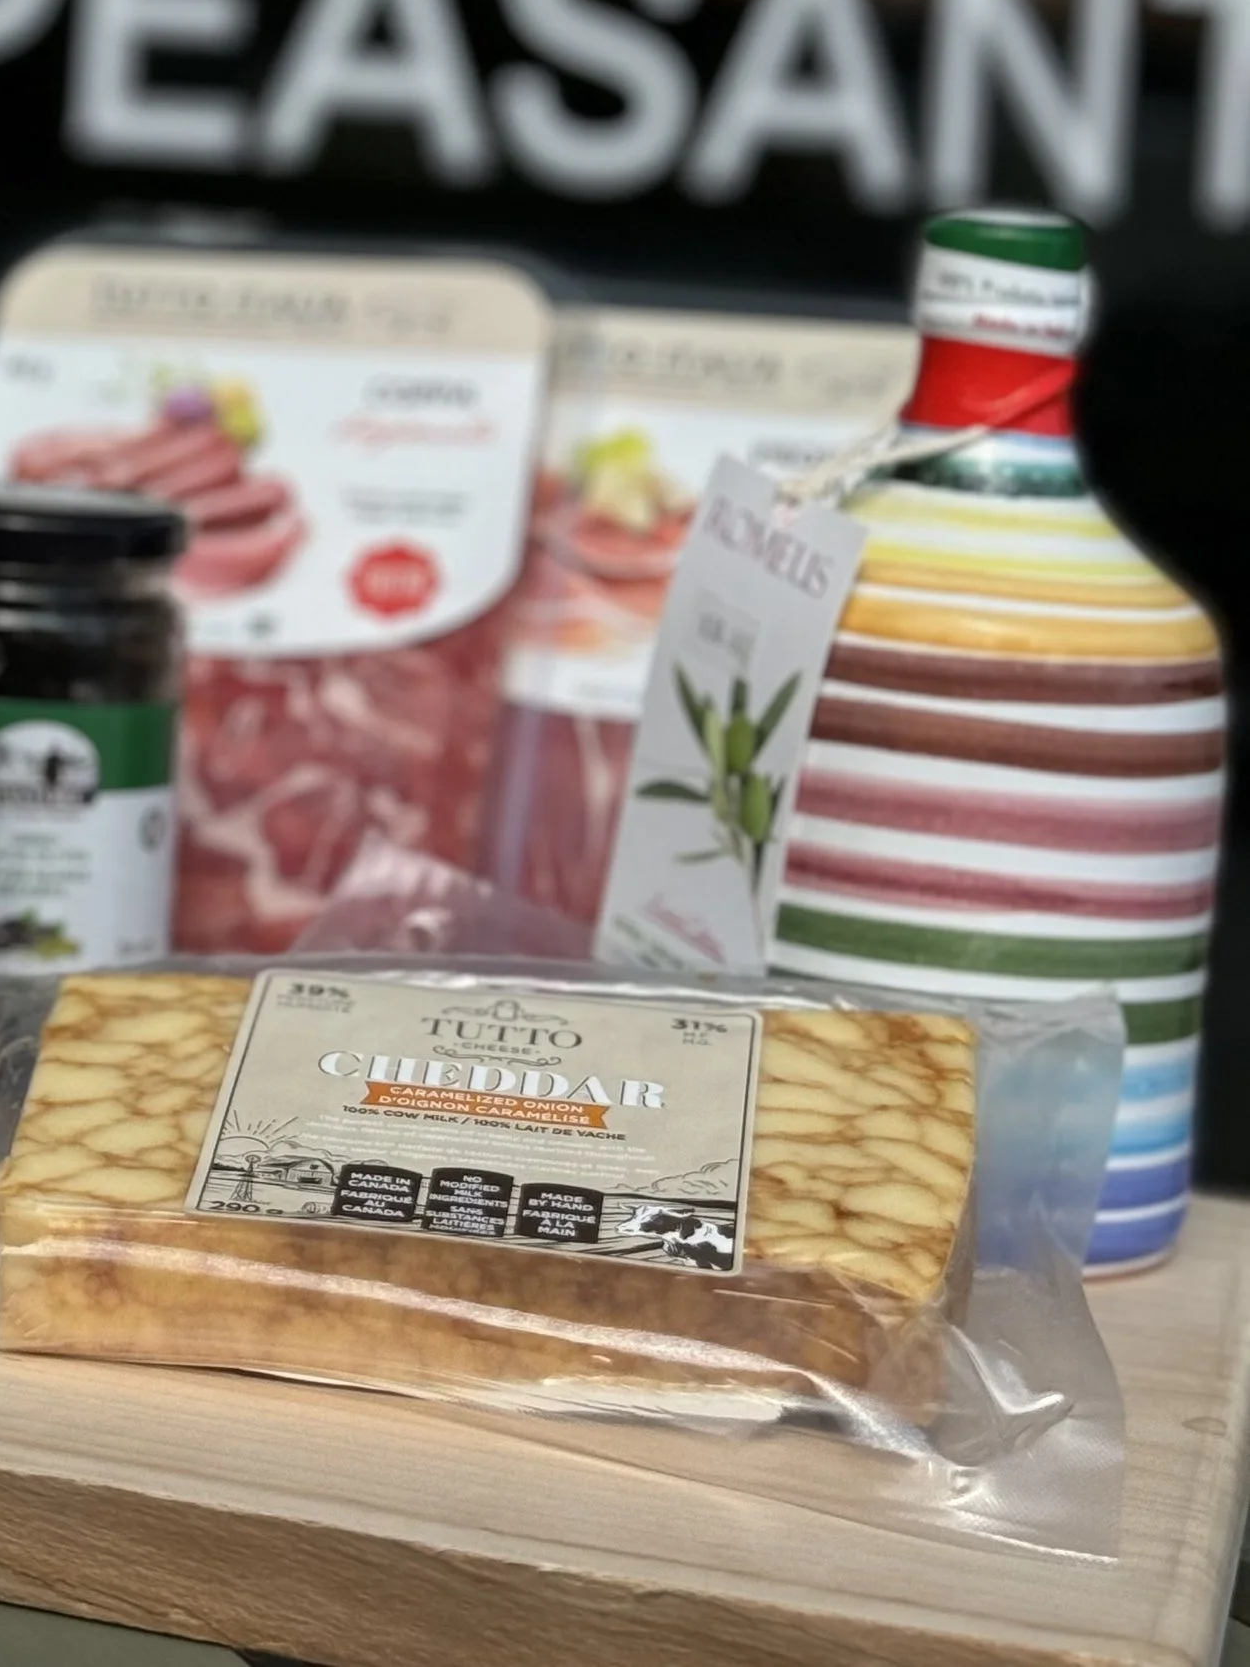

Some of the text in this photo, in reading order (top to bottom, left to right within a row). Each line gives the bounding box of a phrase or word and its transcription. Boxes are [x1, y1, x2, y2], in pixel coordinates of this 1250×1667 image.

[288, 982, 350, 999] 39%
[421, 1016, 583, 1049] TUTTO
[670, 1018, 728, 1034] 31%
[318, 1050, 665, 1109] CHEDDAR
[378, 1095, 470, 1112] D'OIGNON
[389, 1086, 584, 1114] CARAMELIZED ONION
[342, 1105, 380, 1116] 100%
[383, 1109, 420, 1120] COW
[423, 1113, 459, 1123] MILK
[472, 1119, 511, 1130] 100%
[514, 1123, 549, 1134] LAIT
[551, 1128, 573, 1136] DE
[576, 1130, 627, 1141] VACHE
[351, 1172, 411, 1186] MADE IN
[463, 1174, 483, 1183] NO
[348, 1180, 410, 1193] CANADA
[439, 1180, 501, 1193] MODIFIED
[454, 1189, 483, 1198] MILK
[364, 1199, 386, 1208] AU
[429, 1193, 509, 1209] INGREDIENTS
[540, 1192, 584, 1203] MADE
[209, 1200, 261, 1214] 290
[342, 1204, 405, 1218] CANADA
[449, 1205, 484, 1216] SANS
[528, 1198, 594, 1212] BY HAND
[425, 1209, 505, 1226] SUBSTANCES
[555, 1219, 575, 1229] LA
[537, 1225, 576, 1237] MAIN
